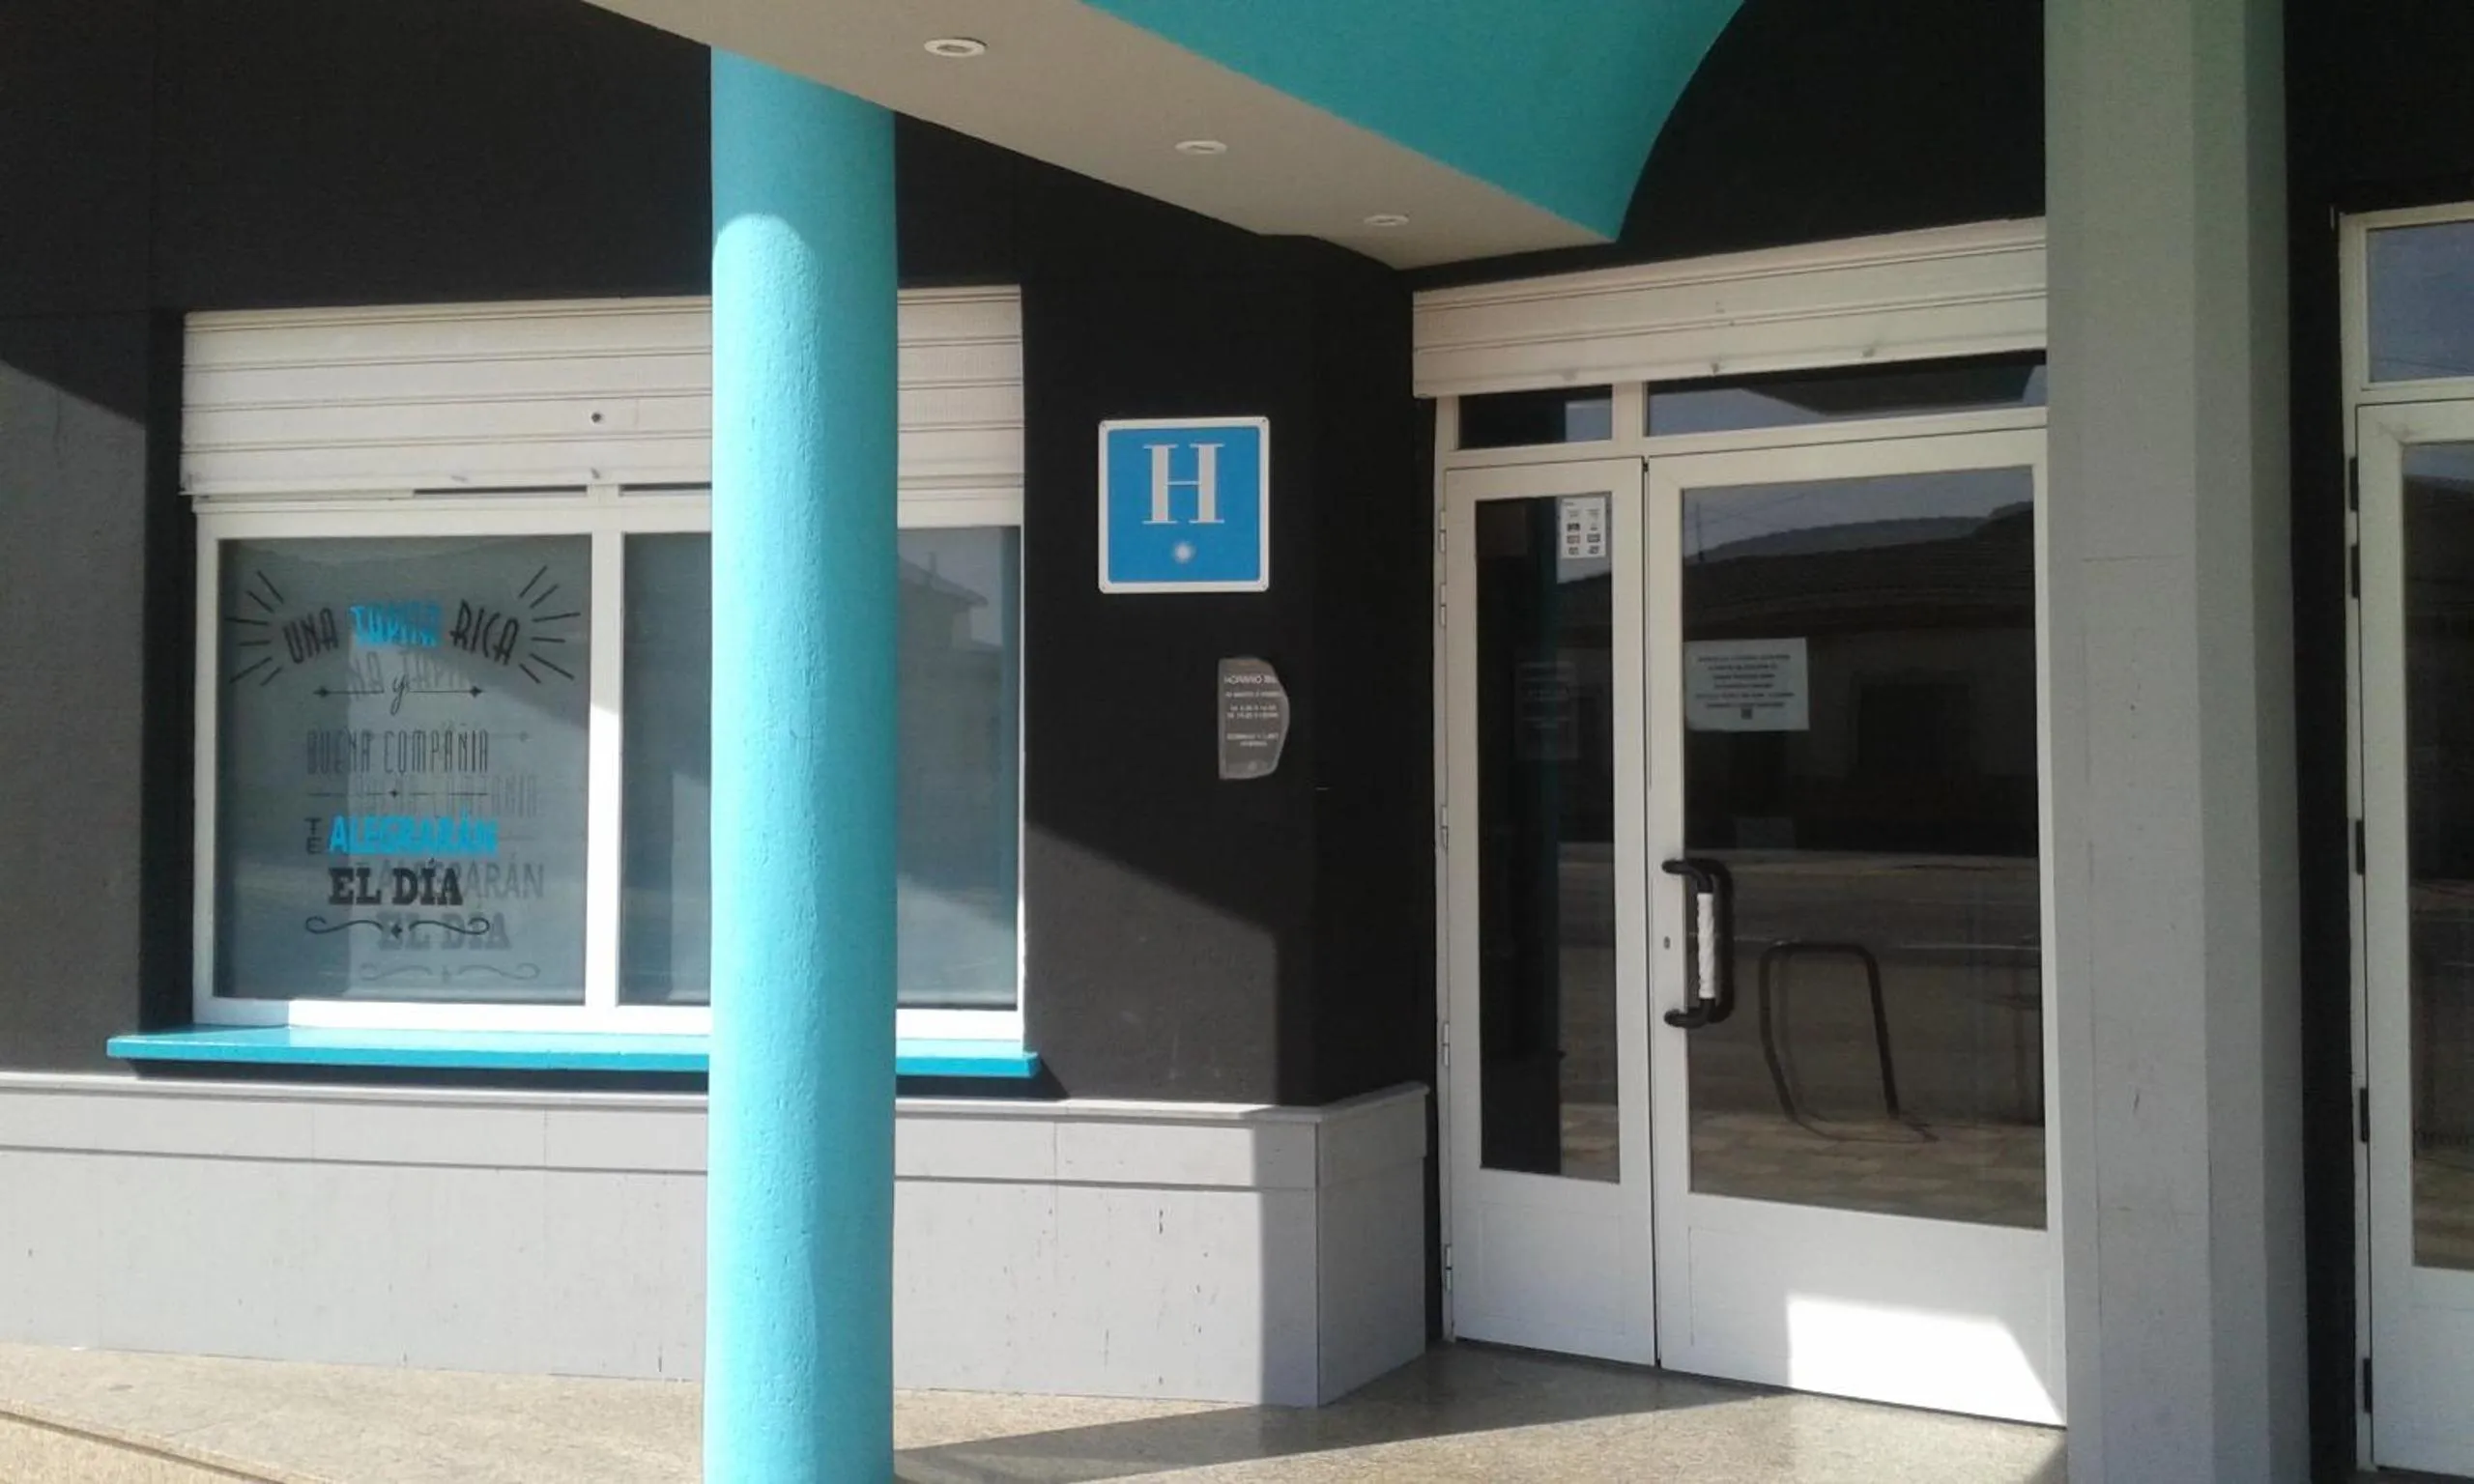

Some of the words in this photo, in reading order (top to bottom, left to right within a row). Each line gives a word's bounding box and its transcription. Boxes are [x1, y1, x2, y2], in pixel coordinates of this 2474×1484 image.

[1142, 443, 1225, 524] H
[283, 607, 338, 664] UNA
[450, 598, 520, 666] RICA
[305, 729, 372, 775] BUENA
[329, 868, 382, 905] EL
[391, 857, 463, 905] DÍA
